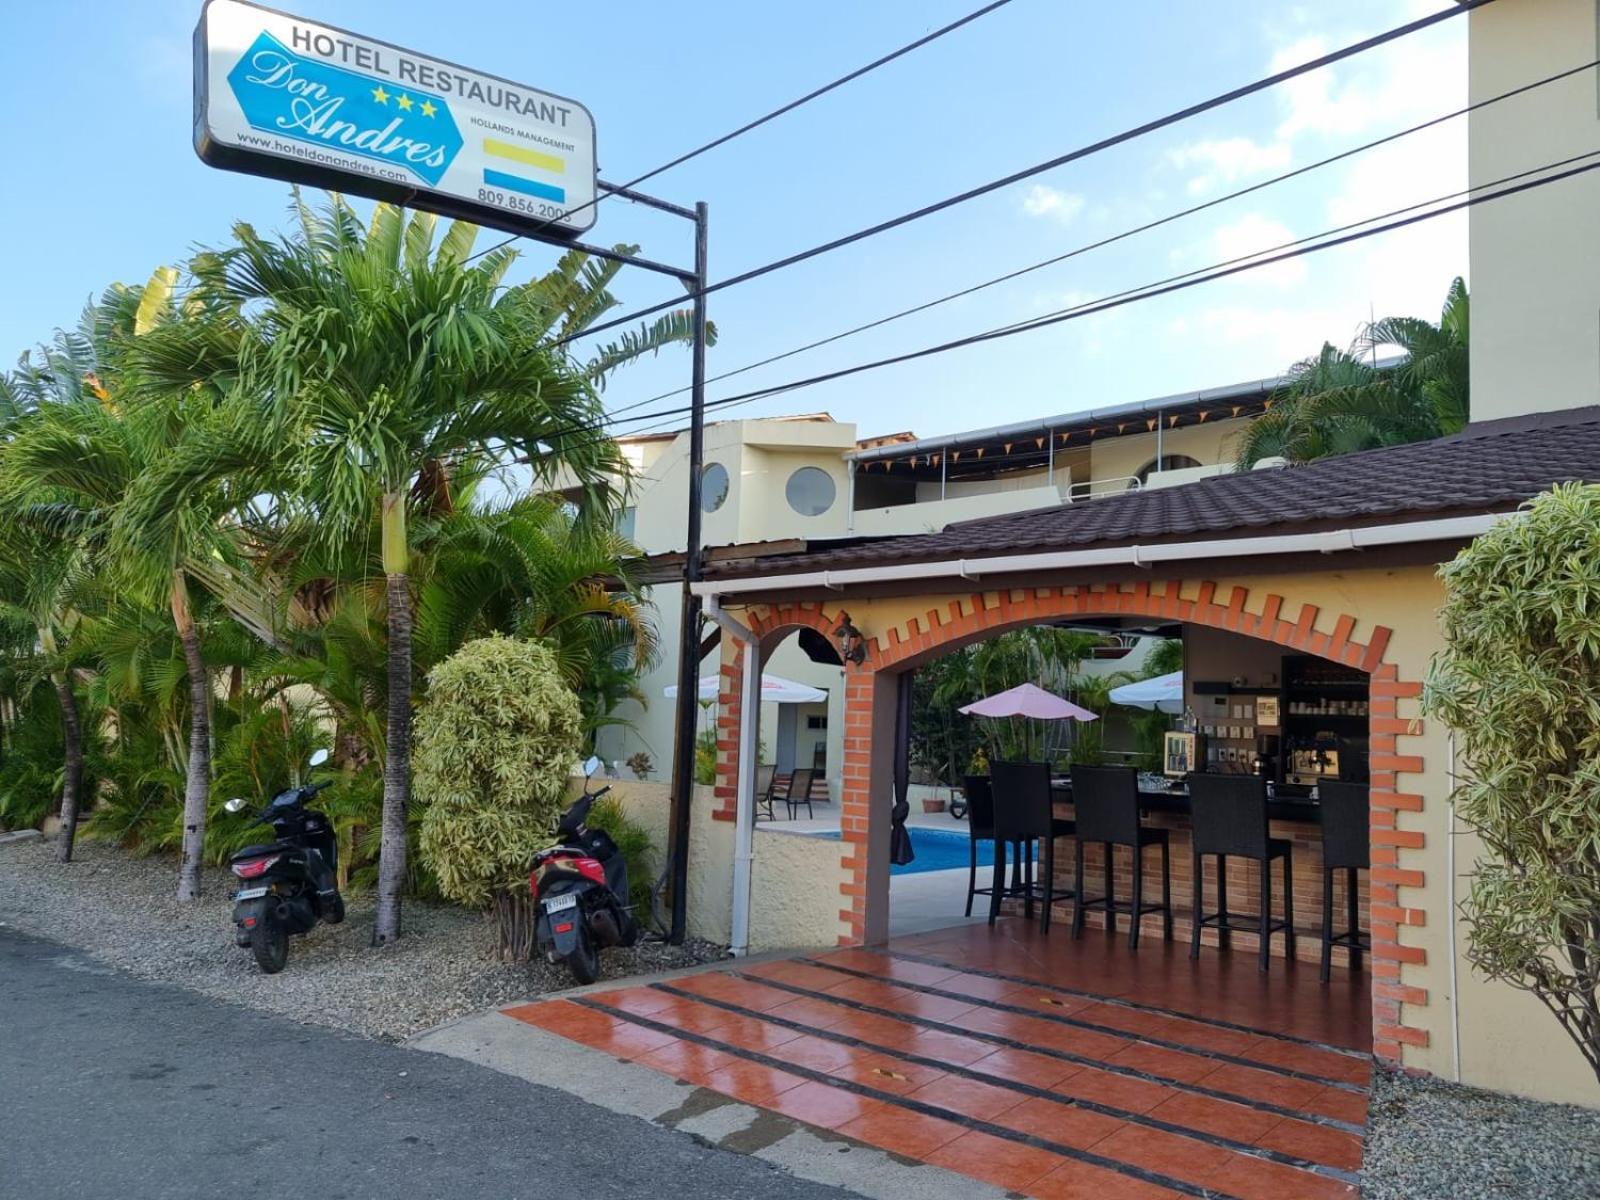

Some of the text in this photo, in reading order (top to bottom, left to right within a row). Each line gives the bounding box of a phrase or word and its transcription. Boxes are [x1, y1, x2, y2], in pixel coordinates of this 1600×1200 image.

[246, 51, 330, 100] Don
[293, 26, 572, 127] HOTEL RESTAURANT
[276, 97, 446, 167] Andres
[470, 116, 575, 152] HOLLANDS MANAGEMENT
[236, 133, 408, 182] www.hoteldonandres.com
